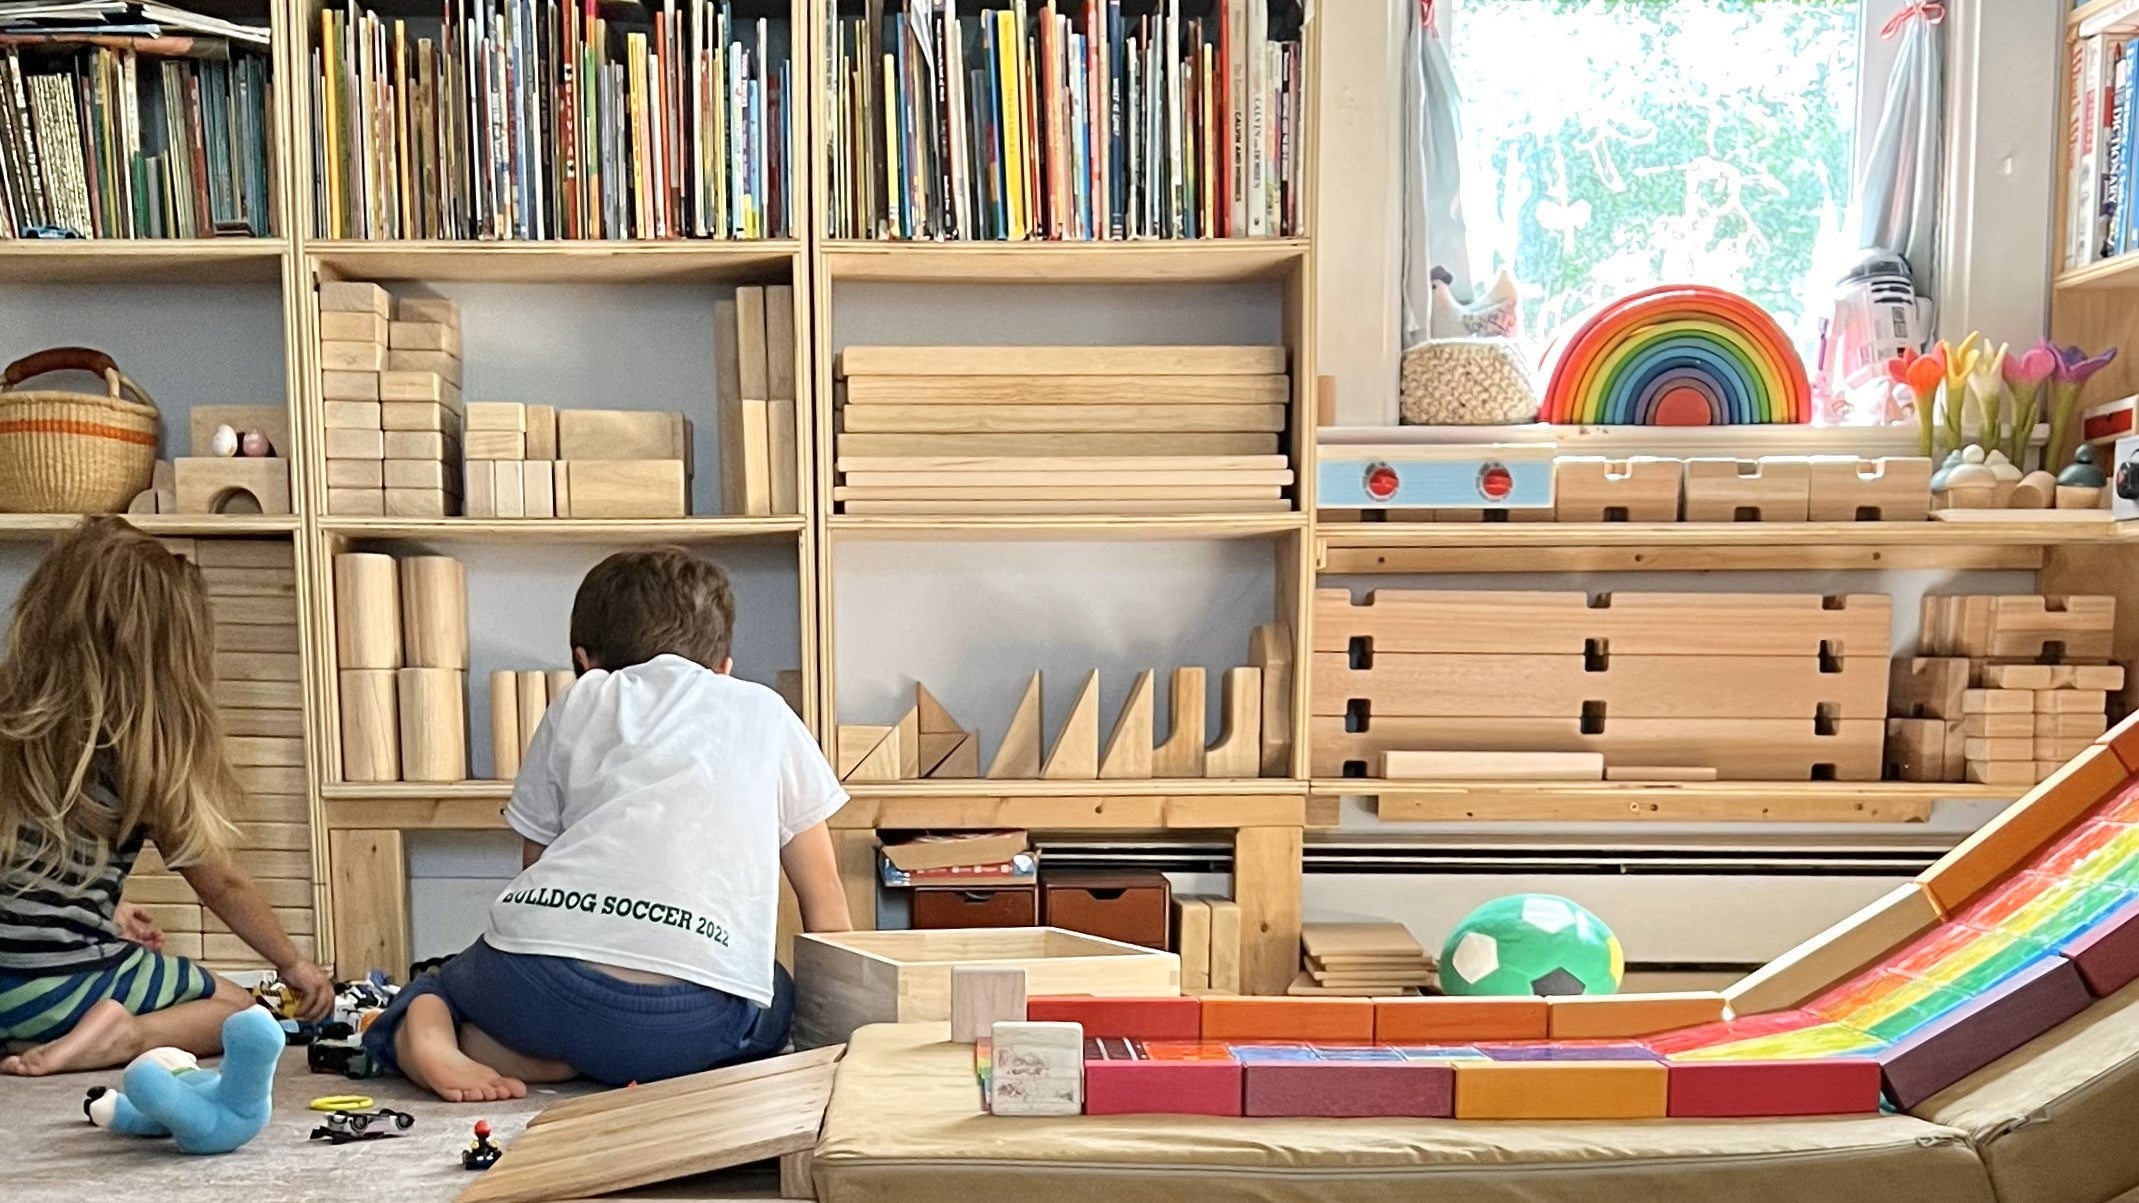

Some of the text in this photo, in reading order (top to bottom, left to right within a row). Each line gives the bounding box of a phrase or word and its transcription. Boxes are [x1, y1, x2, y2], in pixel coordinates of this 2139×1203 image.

[565, 82, 574, 157] OLIVIA
[1234, 111, 1242, 143] CALVIN
[1253, 98, 1261, 137] CALVIN
[2108, 106, 2123, 203] DICTIONARY
[601, 896, 693, 930] SOCCER
[695, 917, 729, 947] 2022
